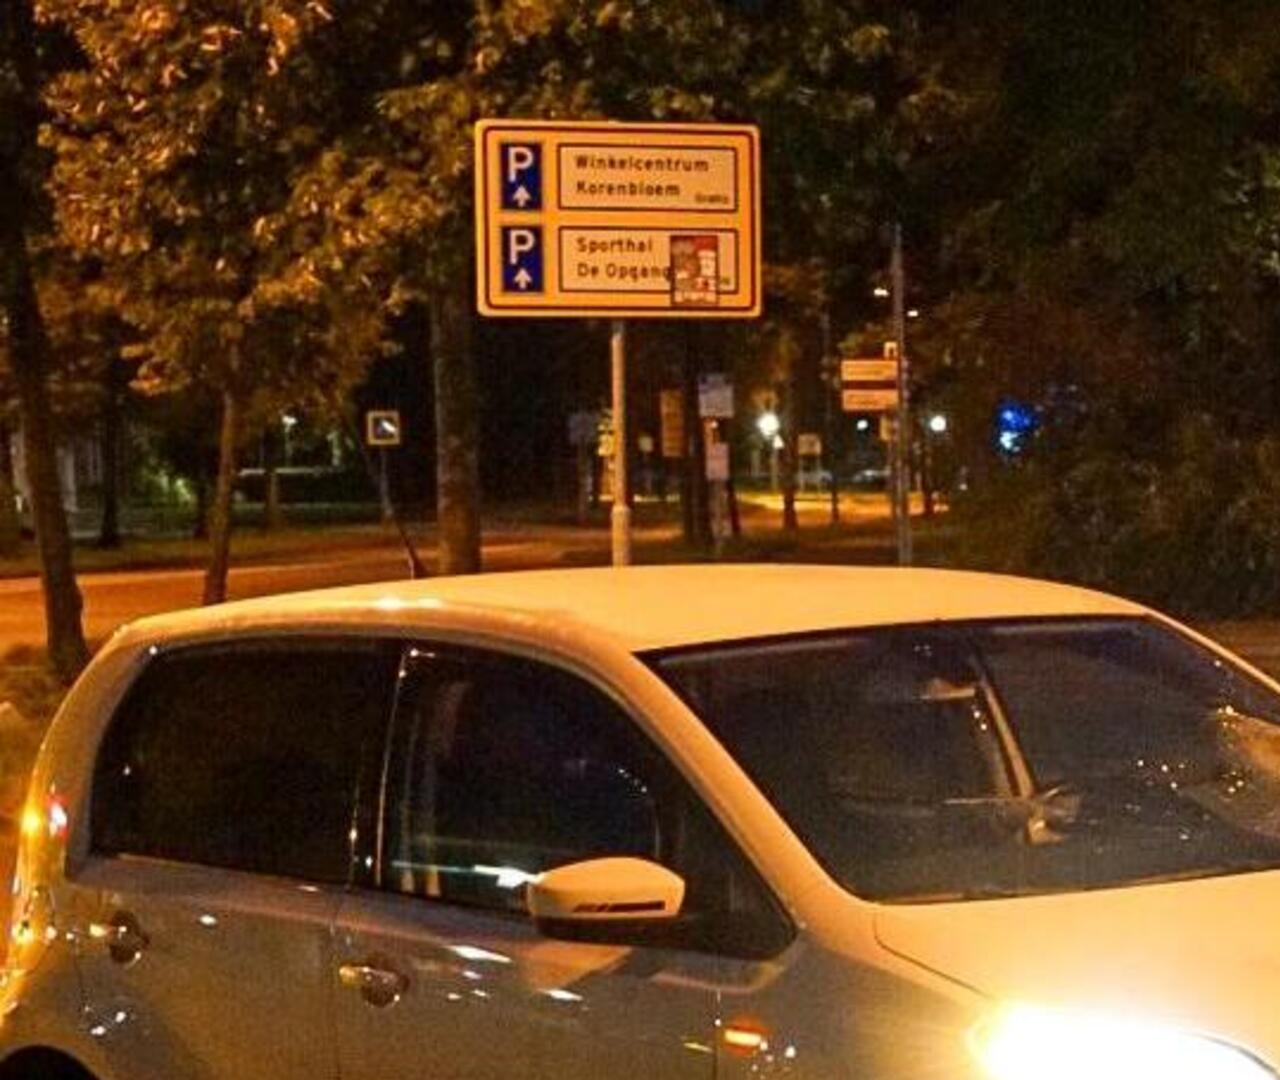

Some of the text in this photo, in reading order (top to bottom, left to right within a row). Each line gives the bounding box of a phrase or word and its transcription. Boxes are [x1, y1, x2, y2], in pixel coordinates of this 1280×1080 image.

[508, 146, 533, 182] P
[575, 154, 709, 172] Winkelcentrum
[576, 181, 680, 196] Korenbloem
[509, 229, 535, 265] P
[576, 237, 653, 254] Sporthal
[577, 263, 599, 277] De
